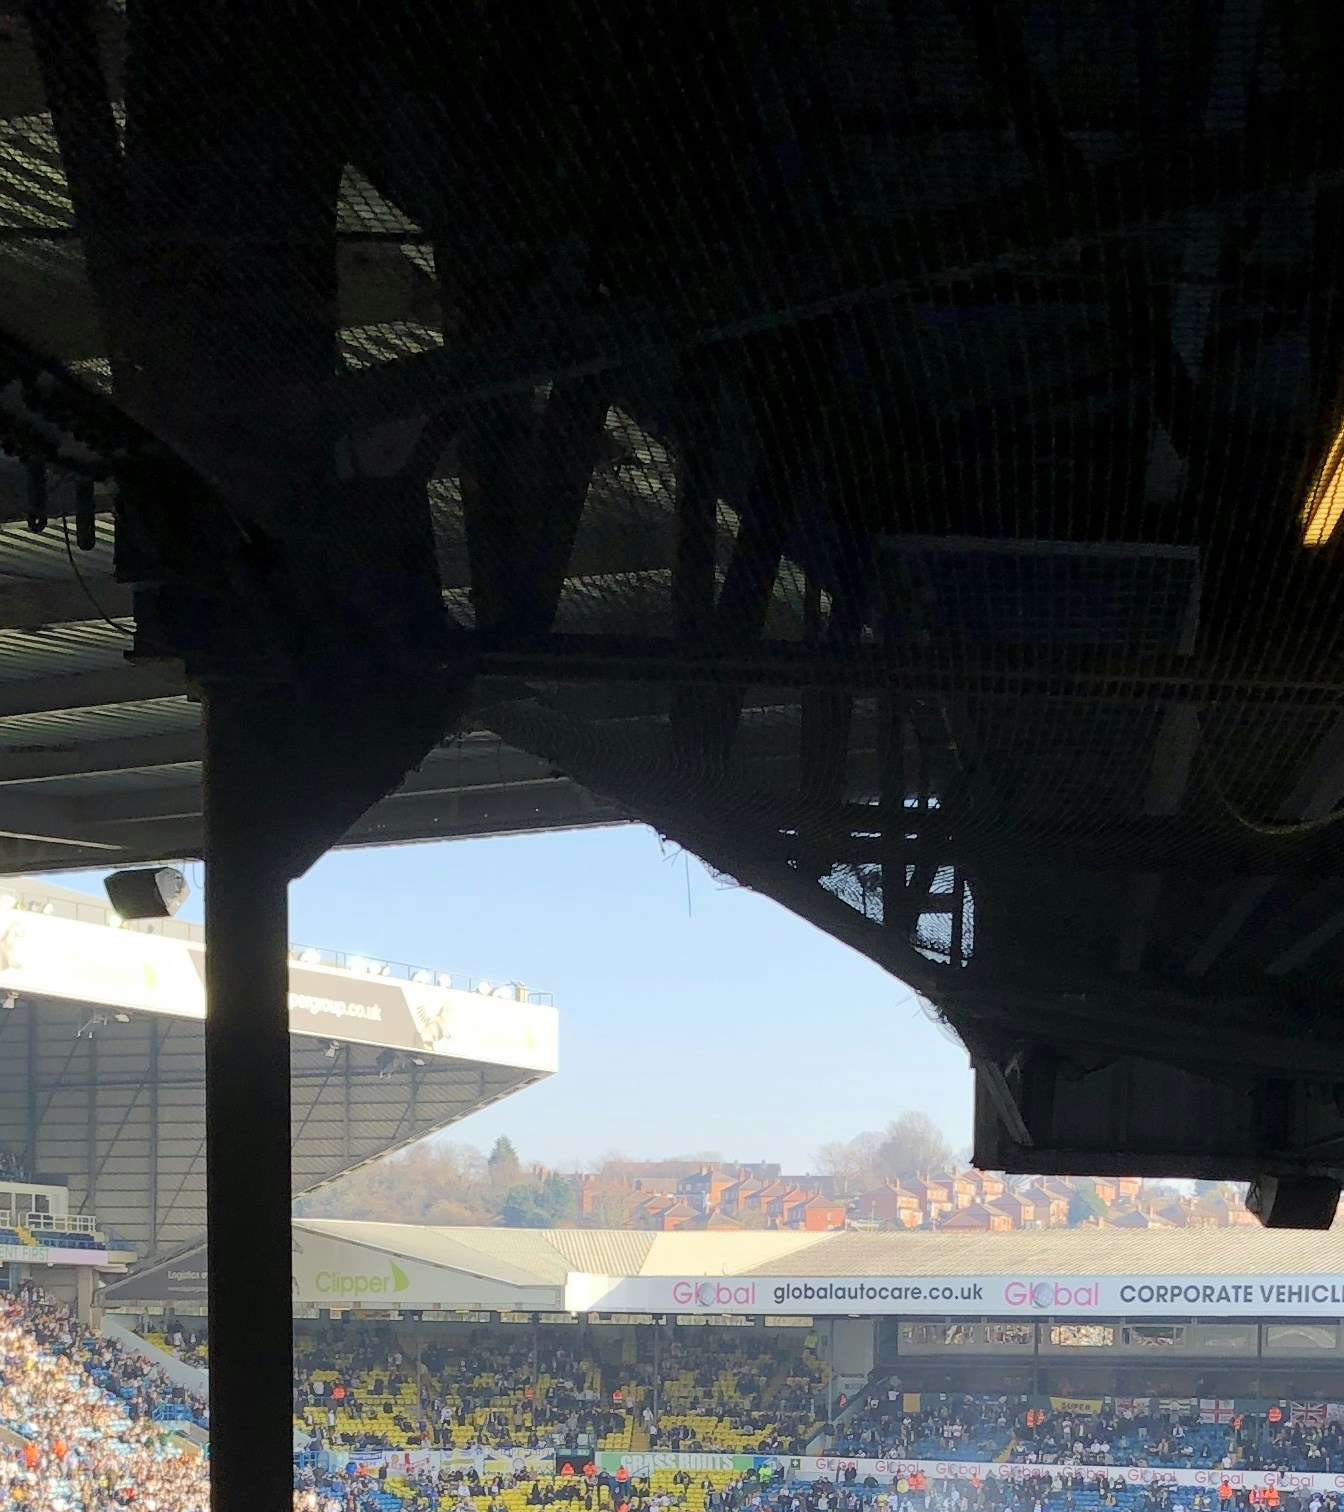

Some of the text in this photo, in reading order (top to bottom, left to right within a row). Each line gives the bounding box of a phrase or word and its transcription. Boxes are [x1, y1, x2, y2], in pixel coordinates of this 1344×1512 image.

[167, 1270, 200, 1281] Logistics
[316, 1271, 390, 1296] Clipper
[673, 1281, 756, 1306] Global
[774, 1282, 983, 1304] globalautocare.co.uk
[1004, 1281, 1099, 1308] Global
[1120, 1284, 1254, 1304] CORPORATE
[1061, 1402, 1091, 1411] SUPER
[620, 1454, 674, 1472] GRASS
